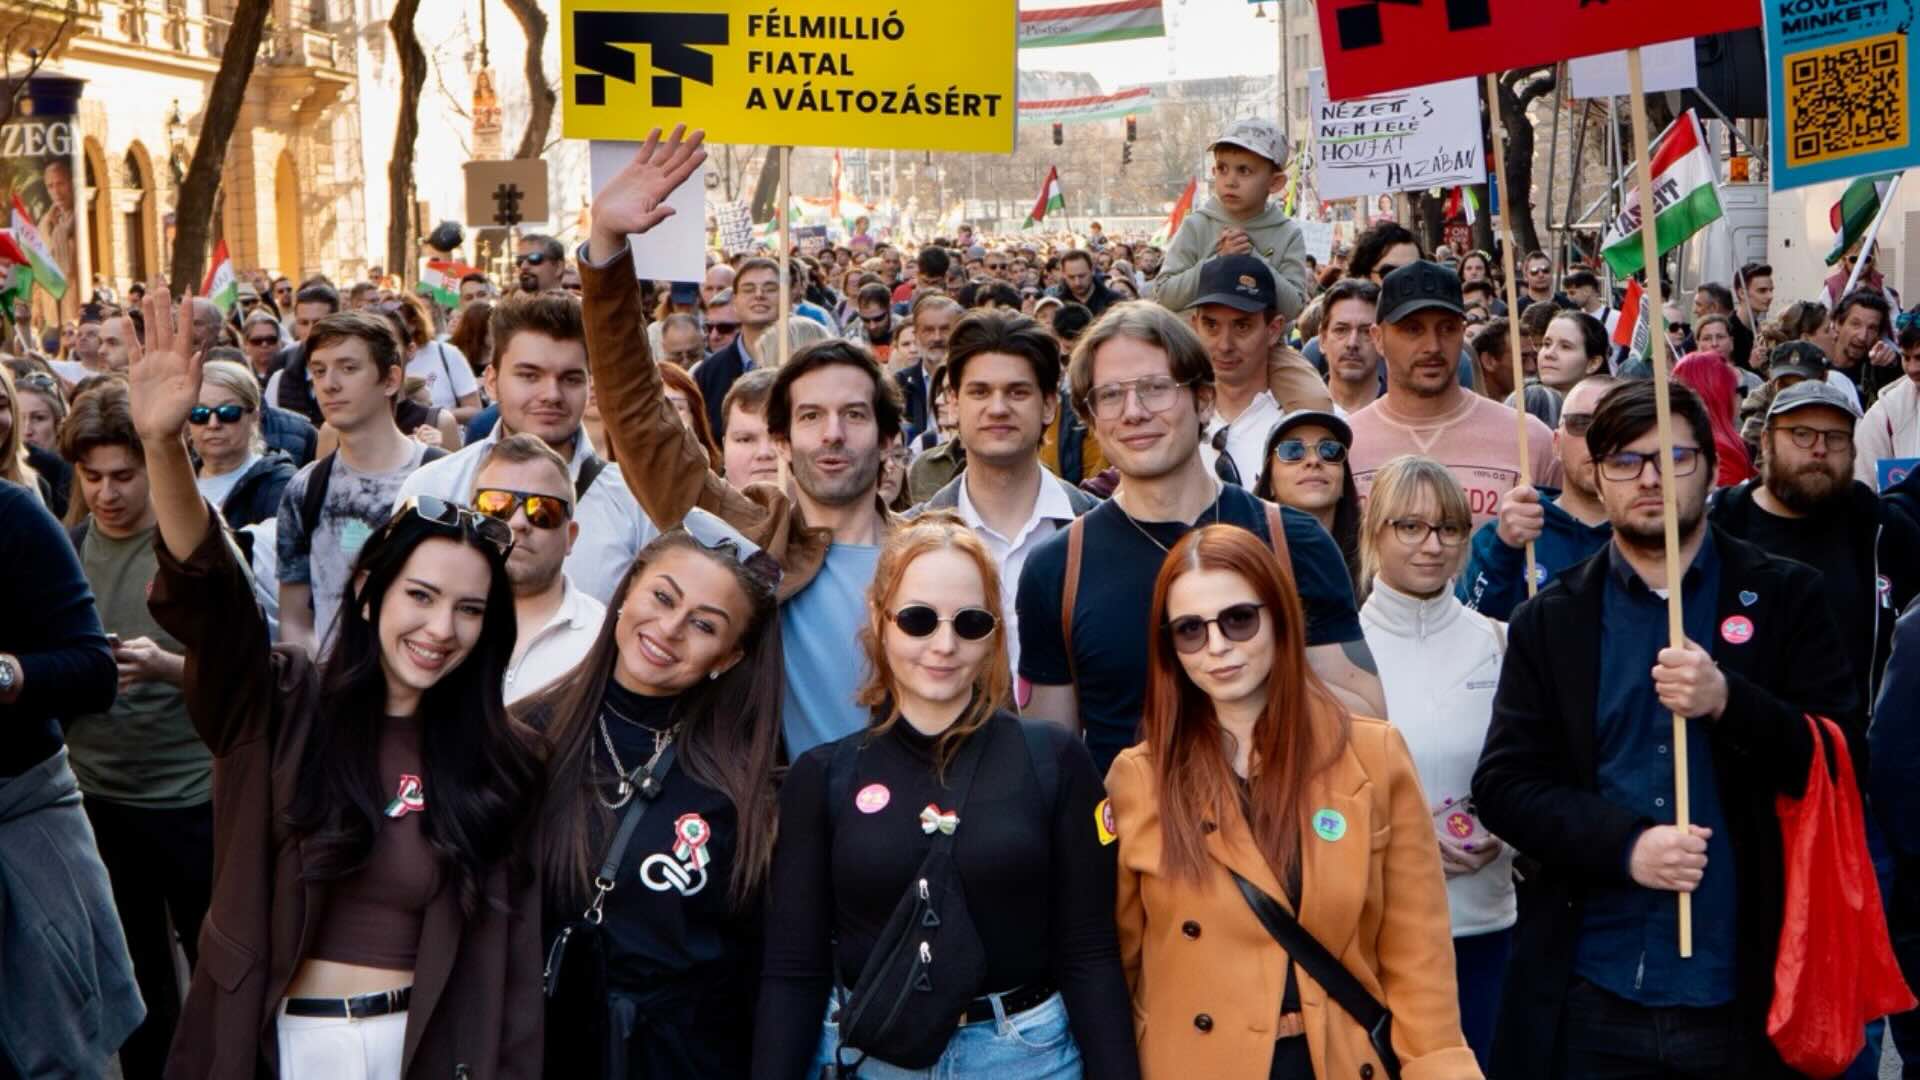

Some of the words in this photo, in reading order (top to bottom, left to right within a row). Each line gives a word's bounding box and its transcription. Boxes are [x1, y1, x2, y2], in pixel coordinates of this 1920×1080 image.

[747, 8, 905, 41] FÉLMILLIÓ
[1782, 2, 1888, 34] MINKET!
[747, 51, 855, 76] FIATAL
[745, 87, 768, 110] A
[772, 81, 1002, 117] VÁLTOZÁSÉRT
